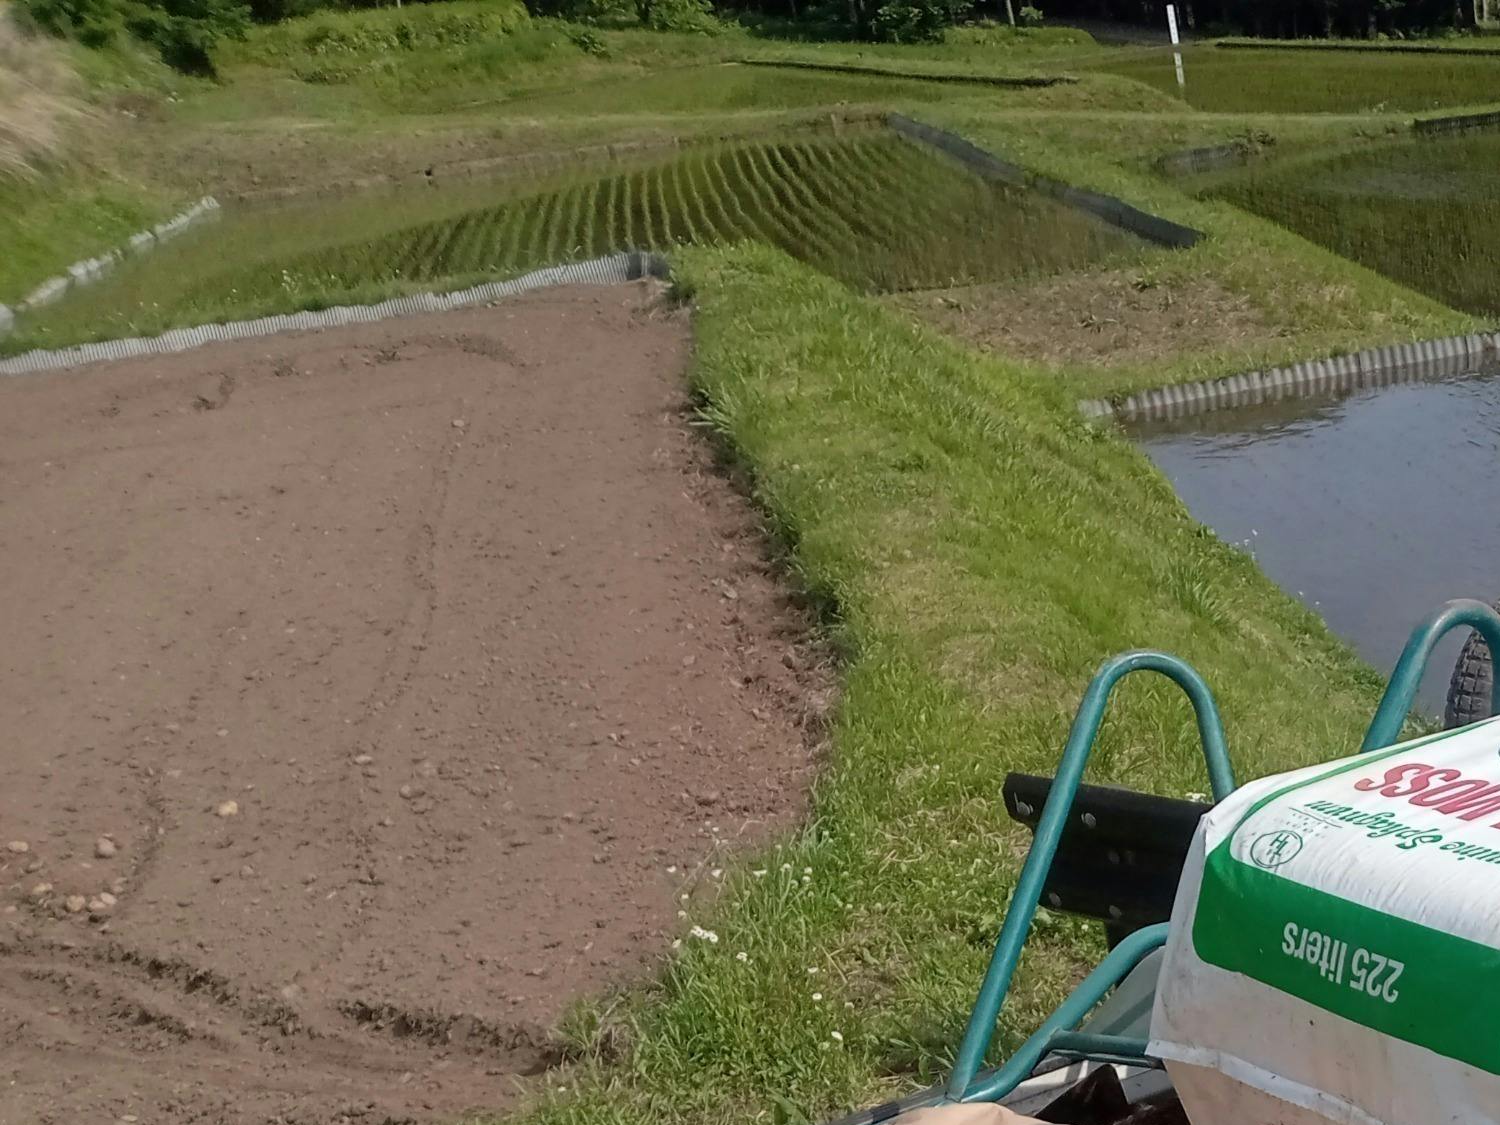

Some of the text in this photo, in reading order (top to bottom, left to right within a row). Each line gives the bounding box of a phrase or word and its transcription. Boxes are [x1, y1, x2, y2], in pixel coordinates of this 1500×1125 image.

[1305, 799, 1443, 851] Sphagnum
[1281, 922, 1406, 1003] 225 liters
